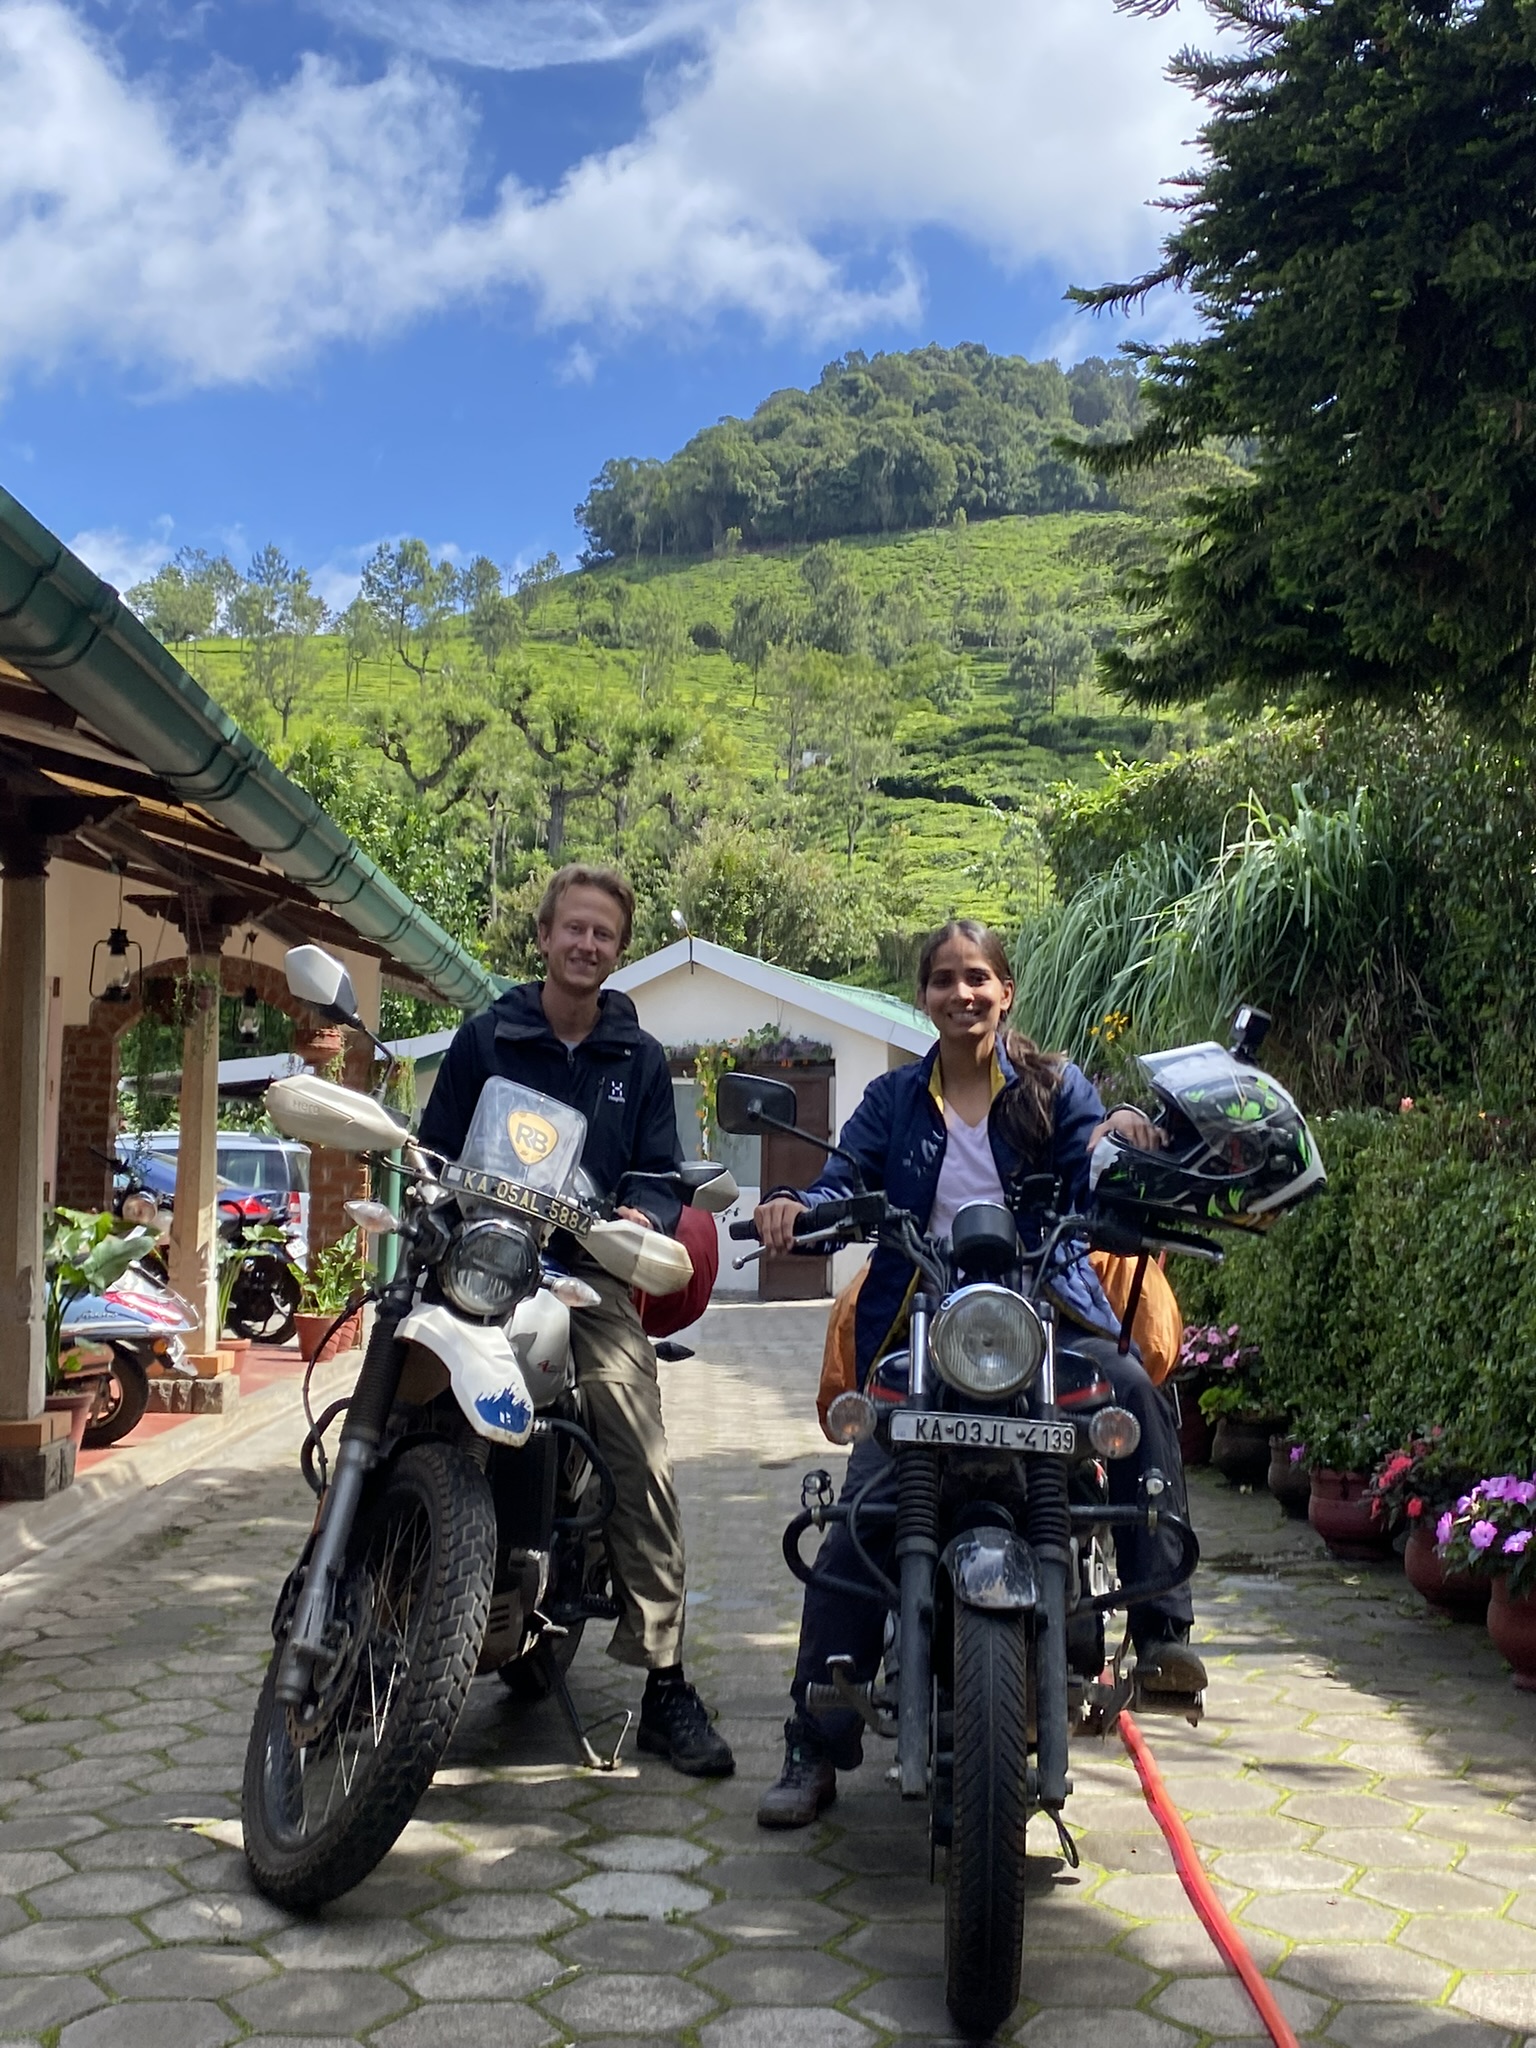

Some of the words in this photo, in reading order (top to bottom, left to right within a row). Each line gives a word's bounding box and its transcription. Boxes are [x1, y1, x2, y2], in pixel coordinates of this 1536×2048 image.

[515, 1122, 549, 1154] RB
[463, 1171, 488, 1194] KA
[496, 1181, 540, 1213] 05AL
[915, 1417, 942, 1441] KA
[1024, 1426, 1074, 1451] 4139
